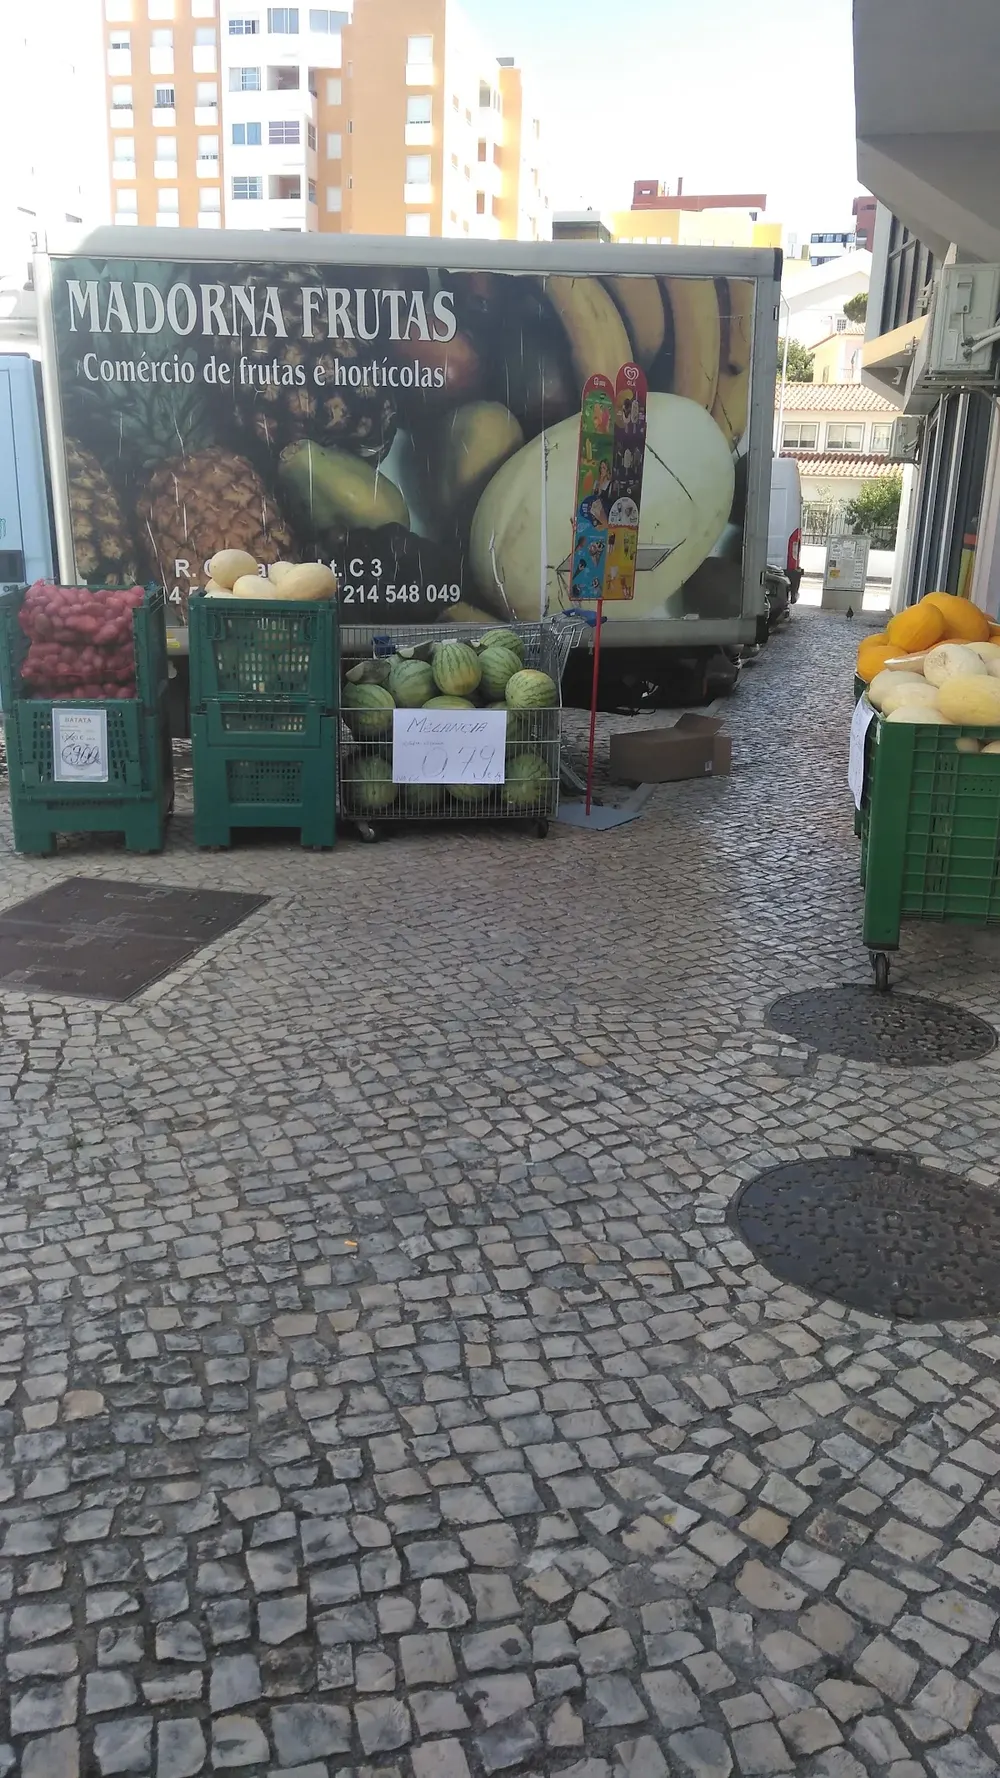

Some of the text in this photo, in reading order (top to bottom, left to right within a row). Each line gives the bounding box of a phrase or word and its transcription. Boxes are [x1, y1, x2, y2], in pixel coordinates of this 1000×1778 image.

[66, 279, 458, 343] MADORNA FRUTAS
[83, 350, 444, 389] Comércio de frutas e hortícolas
[174, 558, 197, 578] R.
[349, 558, 364, 577] C
[371, 558, 383, 577] 3
[343, 583, 379, 604] 214
[385, 583, 420, 603] 548
[426, 583, 461, 603] 049
[407, 716, 488, 733] MELANCIA
[421, 745, 496, 779] 0,79
